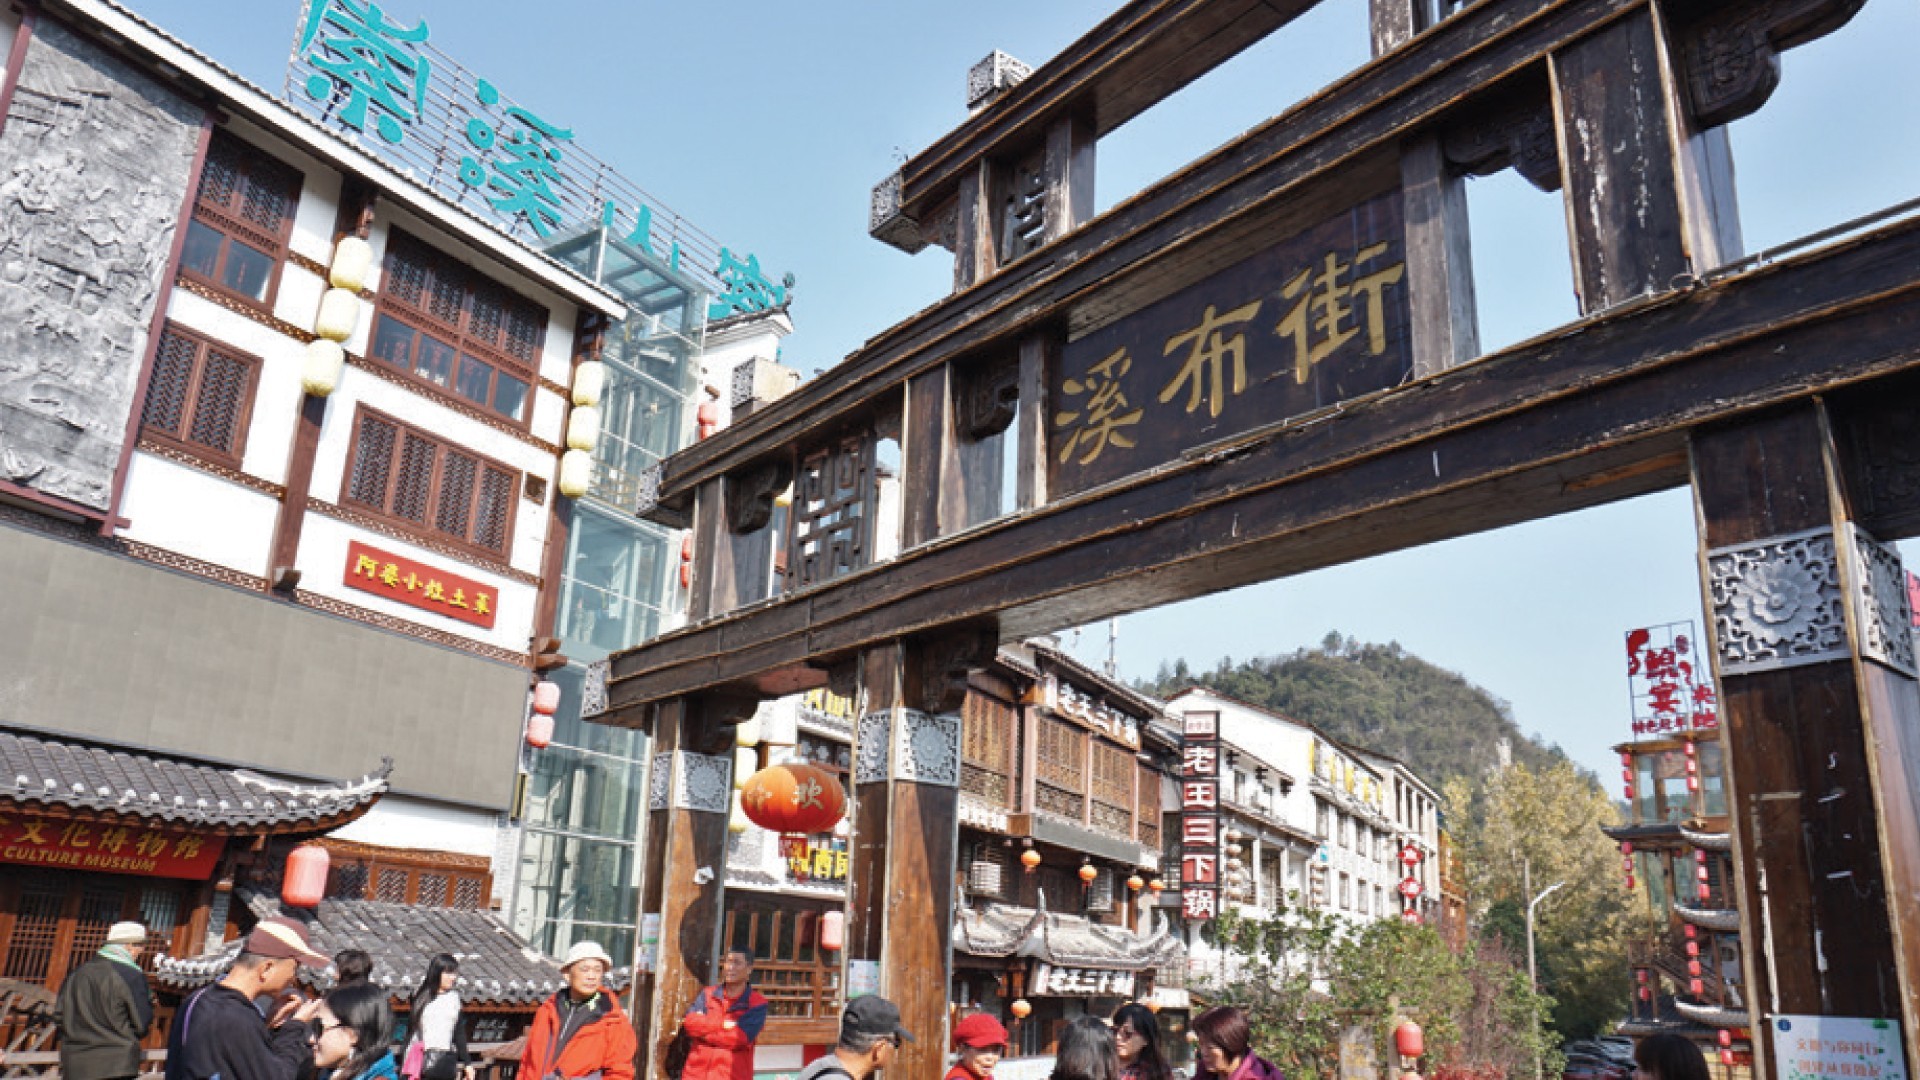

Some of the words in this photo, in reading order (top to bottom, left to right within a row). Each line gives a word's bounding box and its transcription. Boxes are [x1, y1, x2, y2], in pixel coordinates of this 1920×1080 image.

[1055, 241, 1405, 465] 溪布街
[4, 845, 80, 865] CULTURE
[83, 853, 157, 873] MUSEUM
[1184, 746, 1217, 919] 老王三下锅
